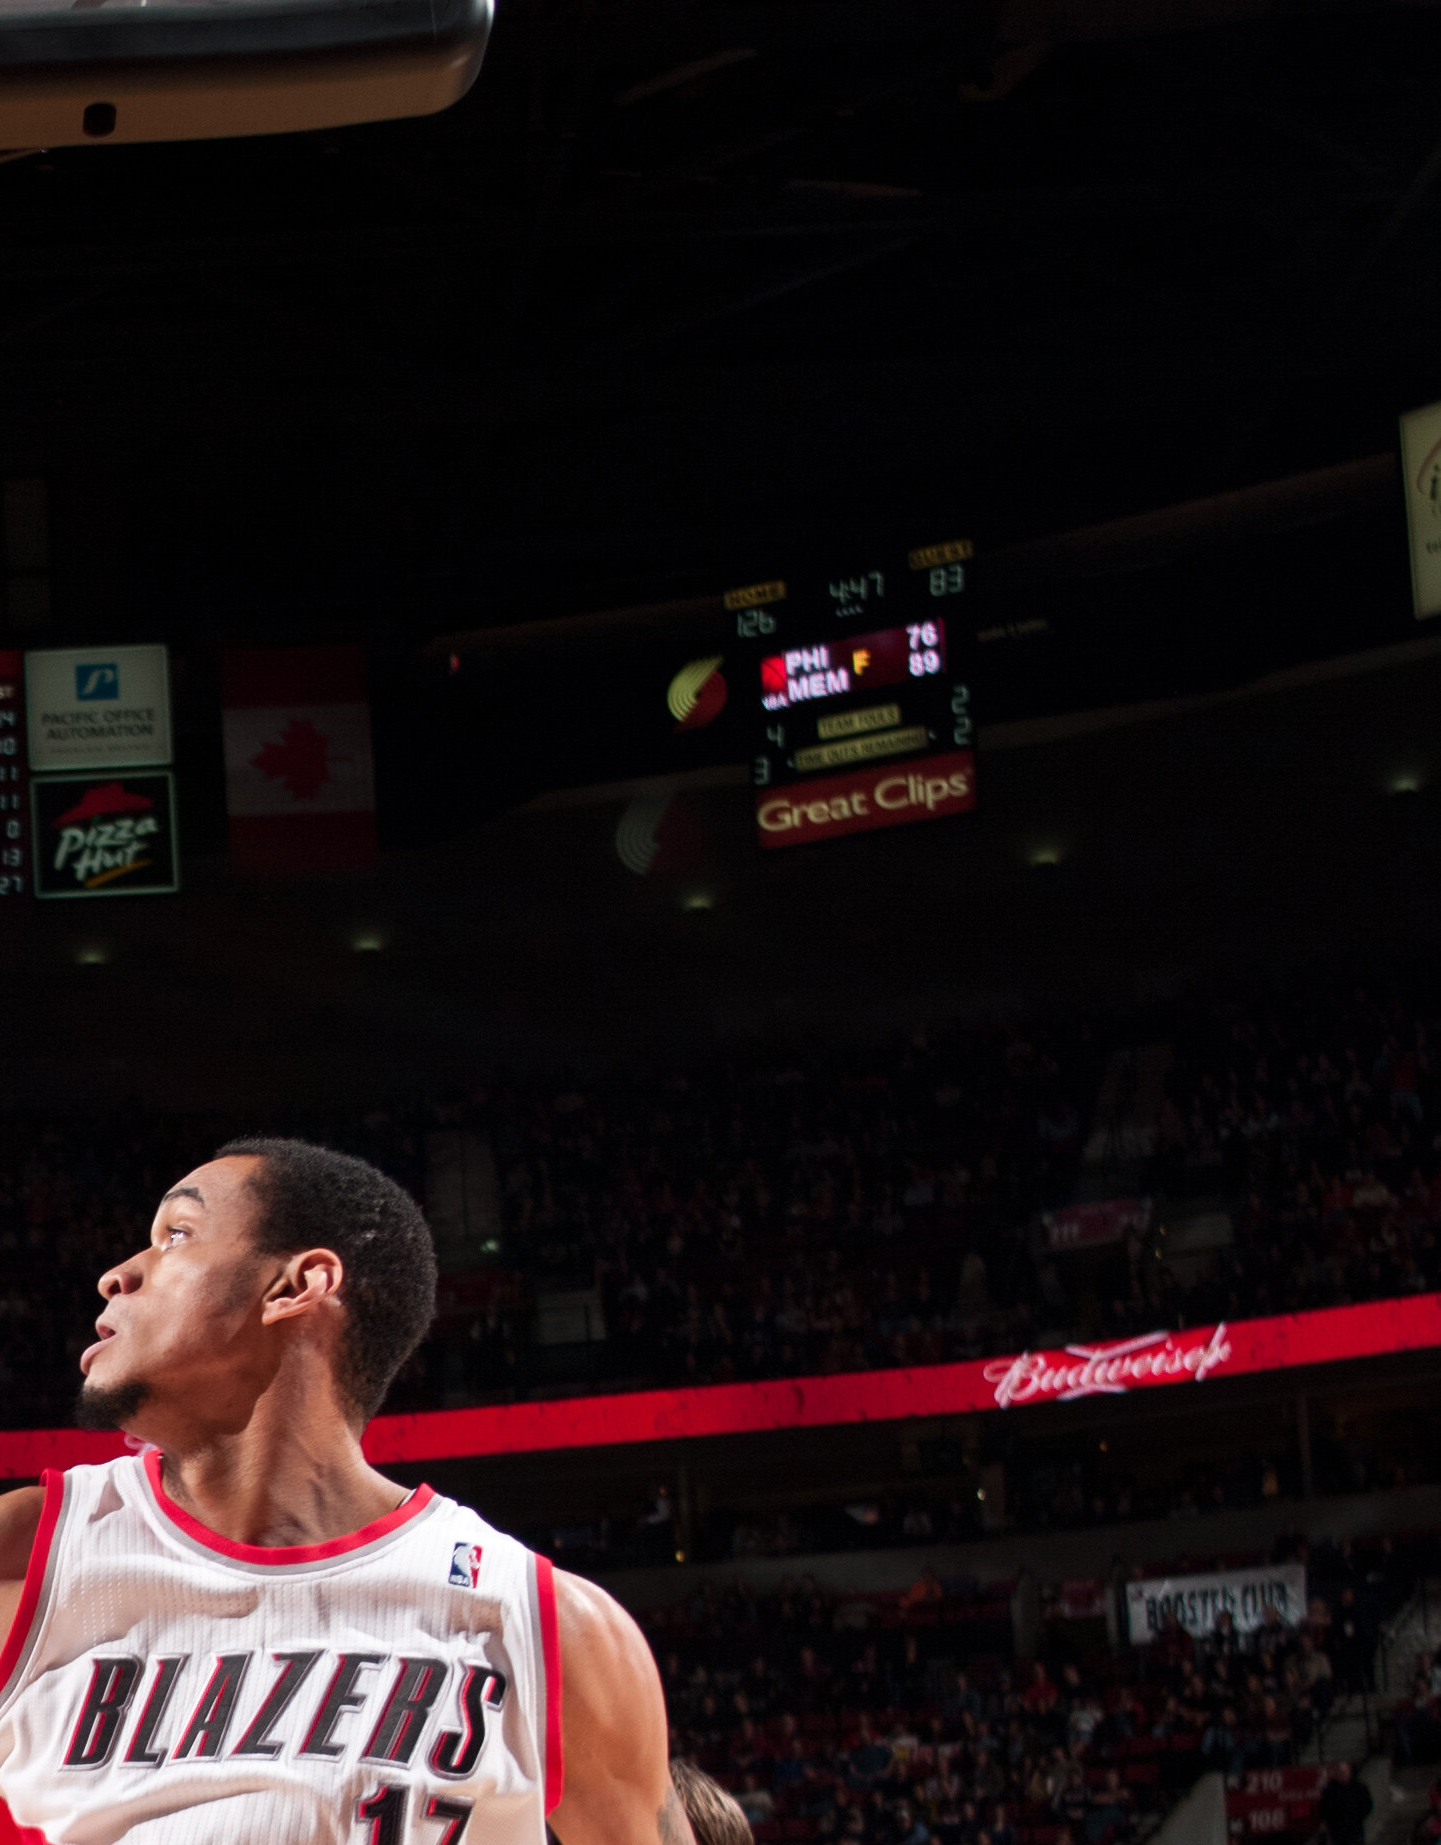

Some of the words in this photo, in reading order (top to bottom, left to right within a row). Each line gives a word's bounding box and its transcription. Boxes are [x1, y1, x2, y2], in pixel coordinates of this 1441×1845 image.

[929, 563, 965, 597] 83
[785, 644, 830, 677] PHI
[906, 620, 939, 651] 76
[787, 666, 852, 704] MEM
[908, 648, 941, 679] 89
[42, 711, 95, 725] PACIFIC
[103, 708, 154, 722] OFFICE
[46, 723, 153, 741] AUTOMATION
[757, 791, 870, 832] Great
[874, 773, 970, 811] Clips
[54, 816, 158, 872] Pizza
[72, 839, 148, 882] Hut
[983, 1321, 1232, 1410] Budweiser
[59, 1649, 508, 1776] BLAZERS
